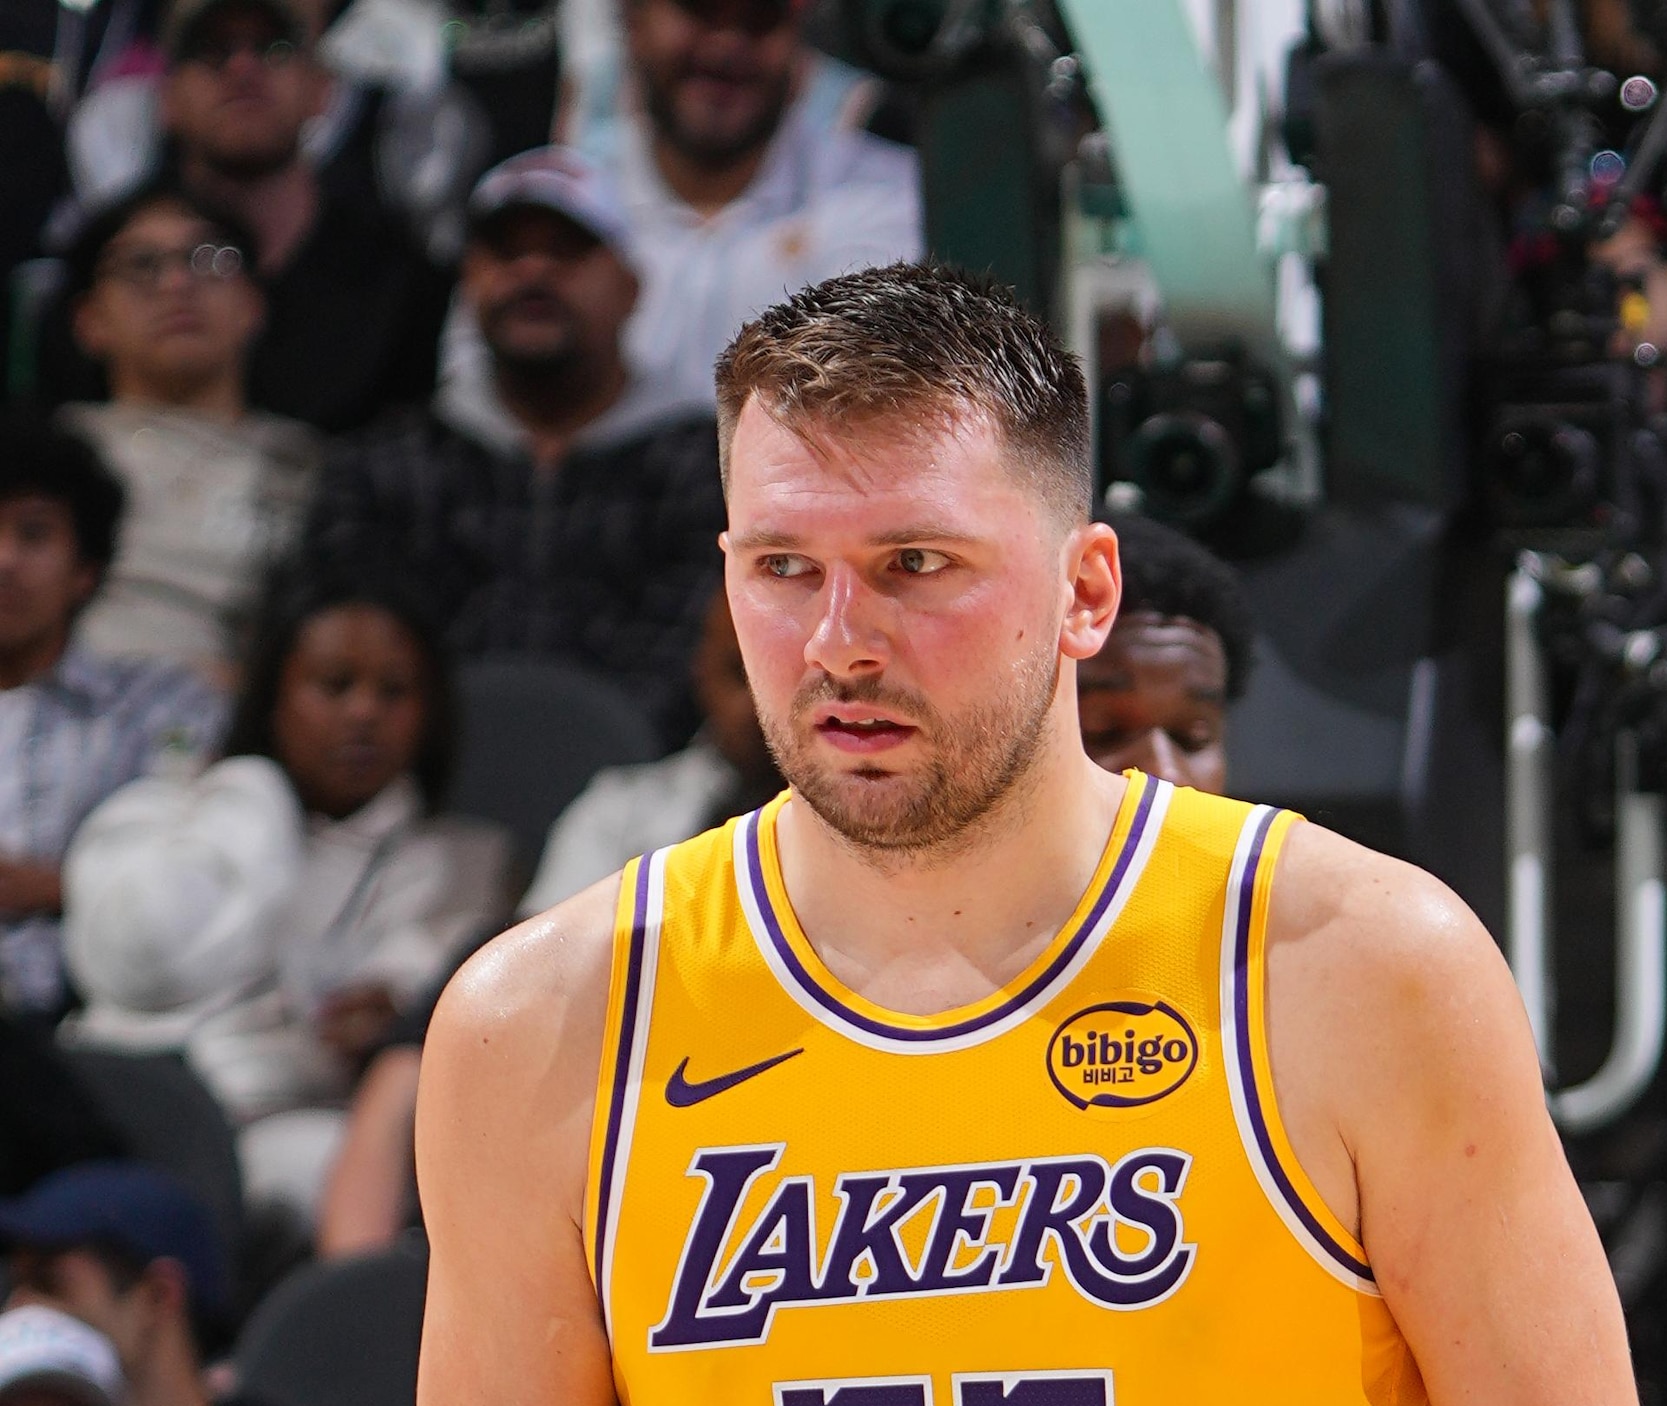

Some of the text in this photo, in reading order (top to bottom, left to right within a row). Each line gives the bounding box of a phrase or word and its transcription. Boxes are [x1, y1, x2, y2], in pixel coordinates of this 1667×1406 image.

[1061, 1029, 1188, 1075] bibigo
[1082, 1067, 1135, 1085] 비비고
[647, 1142, 1199, 1353] LAKERS
